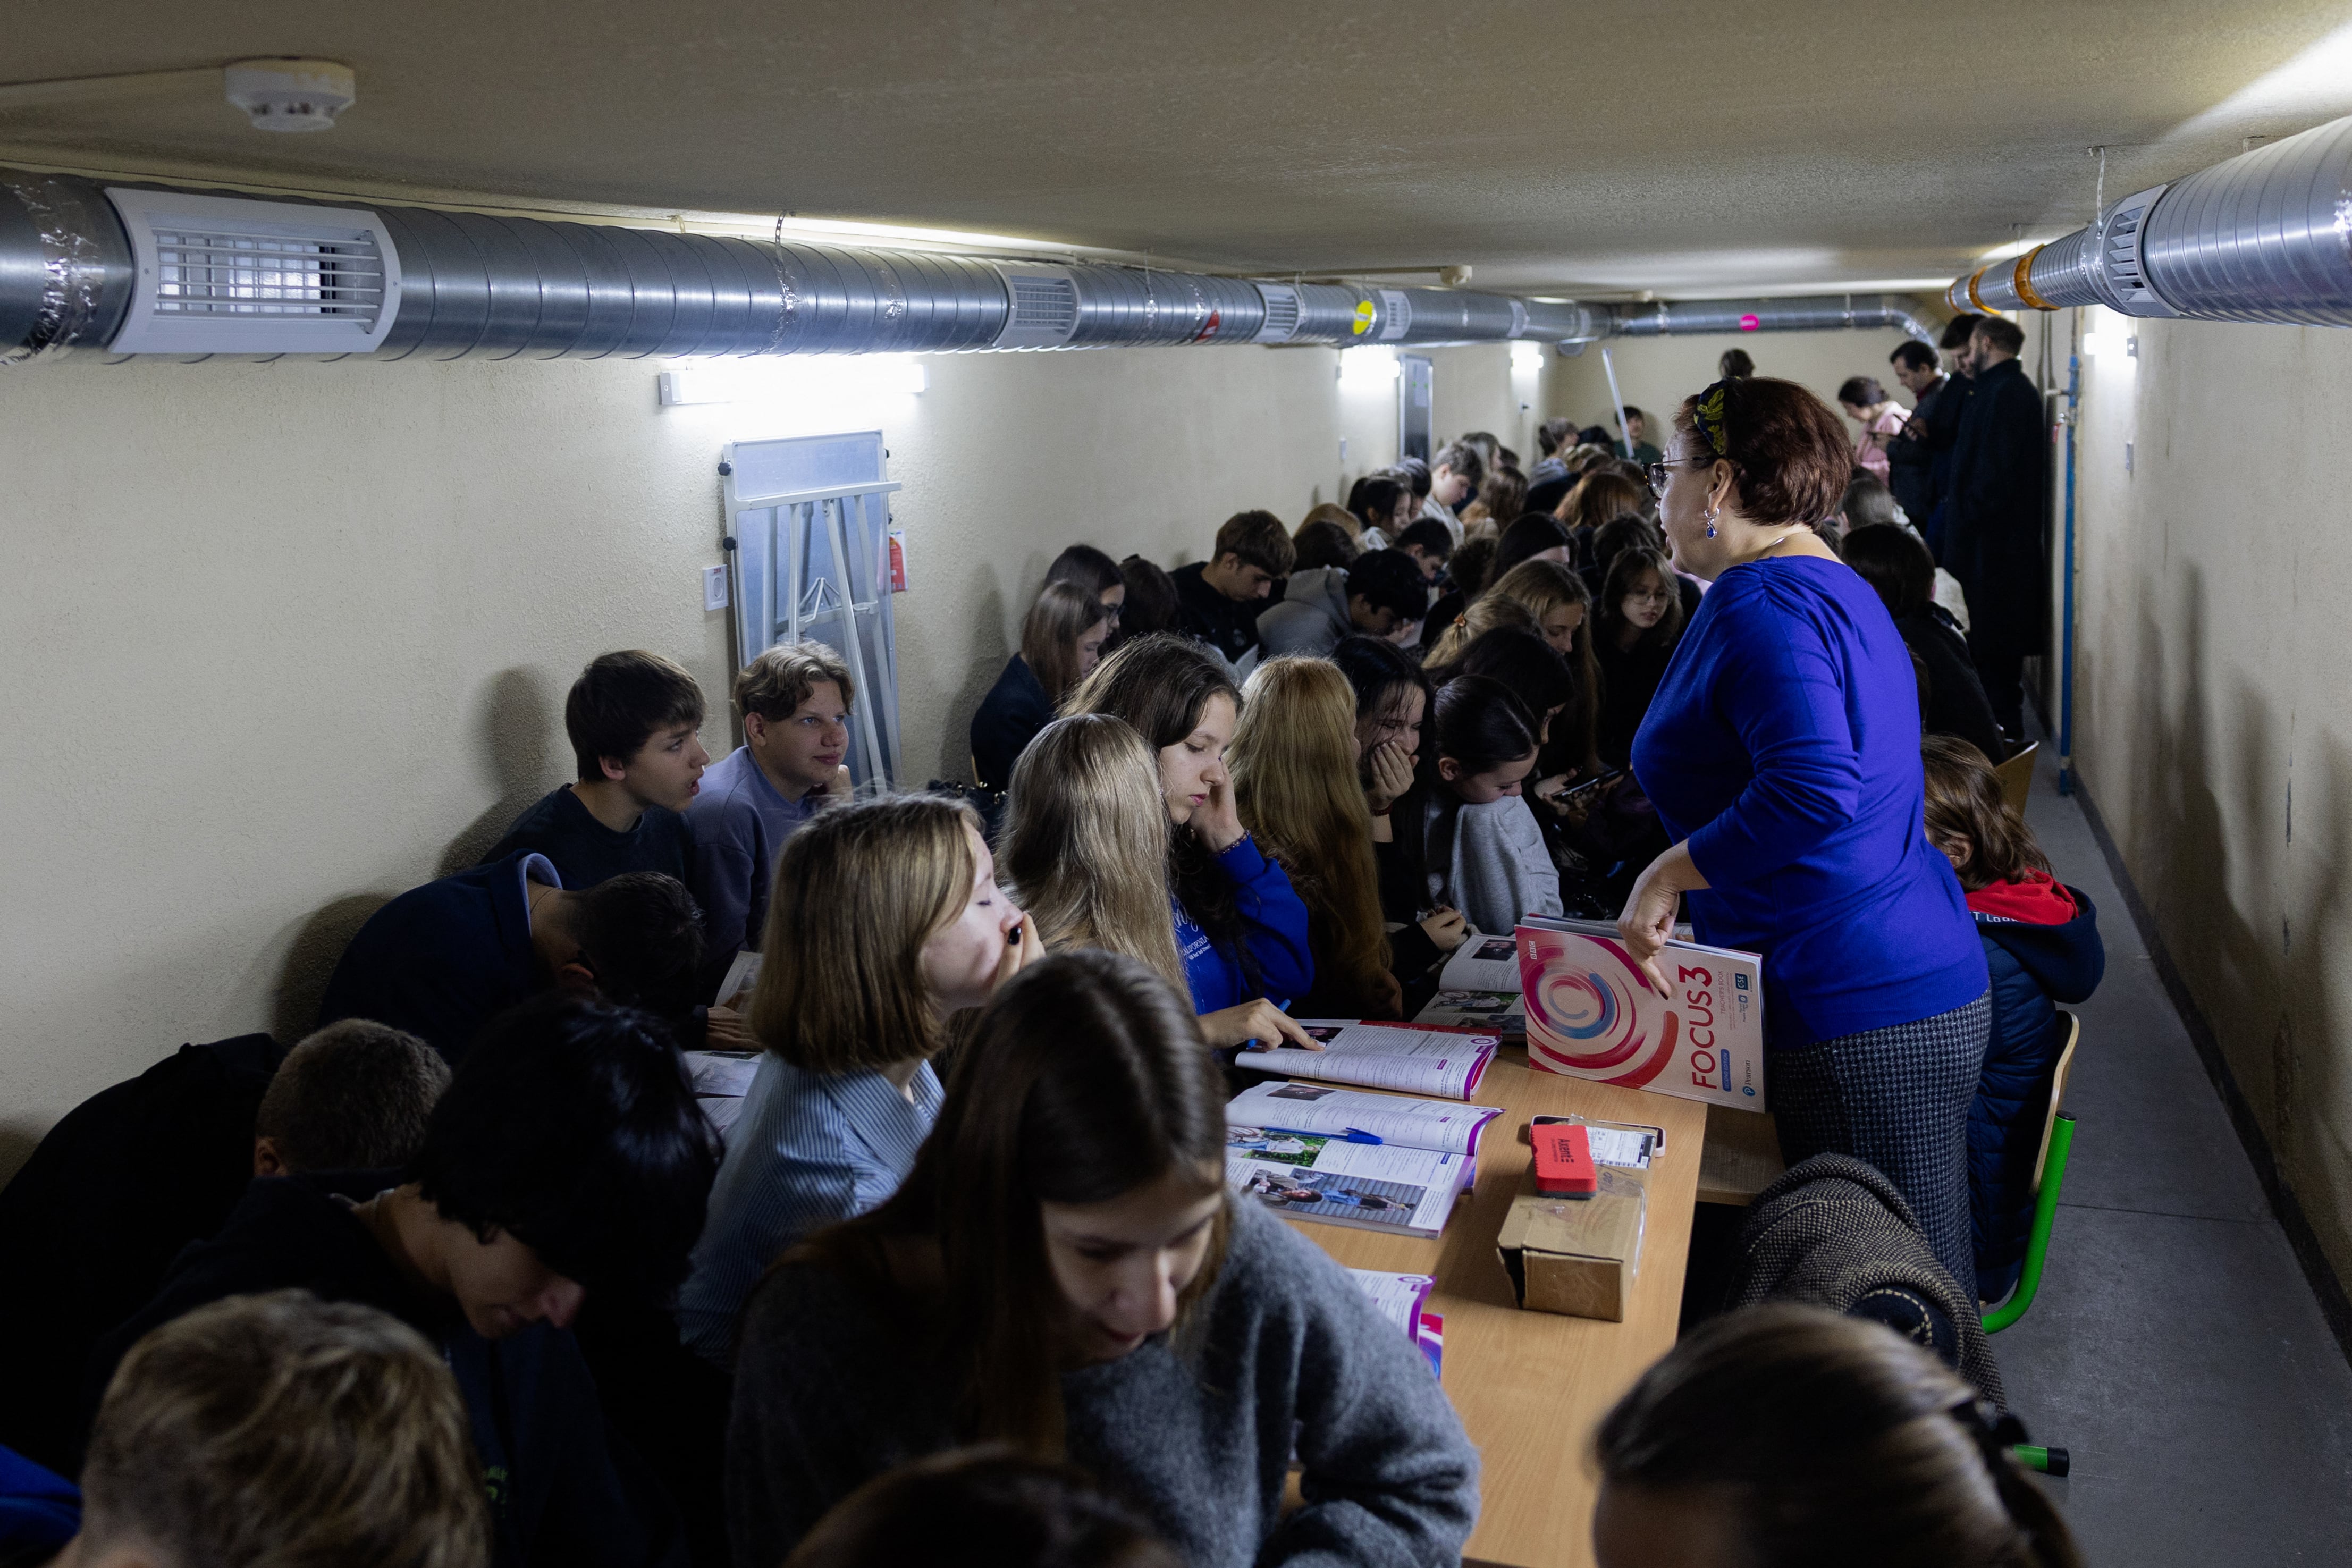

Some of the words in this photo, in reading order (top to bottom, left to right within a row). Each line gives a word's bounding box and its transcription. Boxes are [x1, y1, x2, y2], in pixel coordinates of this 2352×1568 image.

[1183, 935, 1210, 956] ALIFORNIA
[1678, 964, 1713, 987] 3
[1687, 990, 1717, 1089] FOCUS
[1559, 1139, 1571, 1158] Axent
